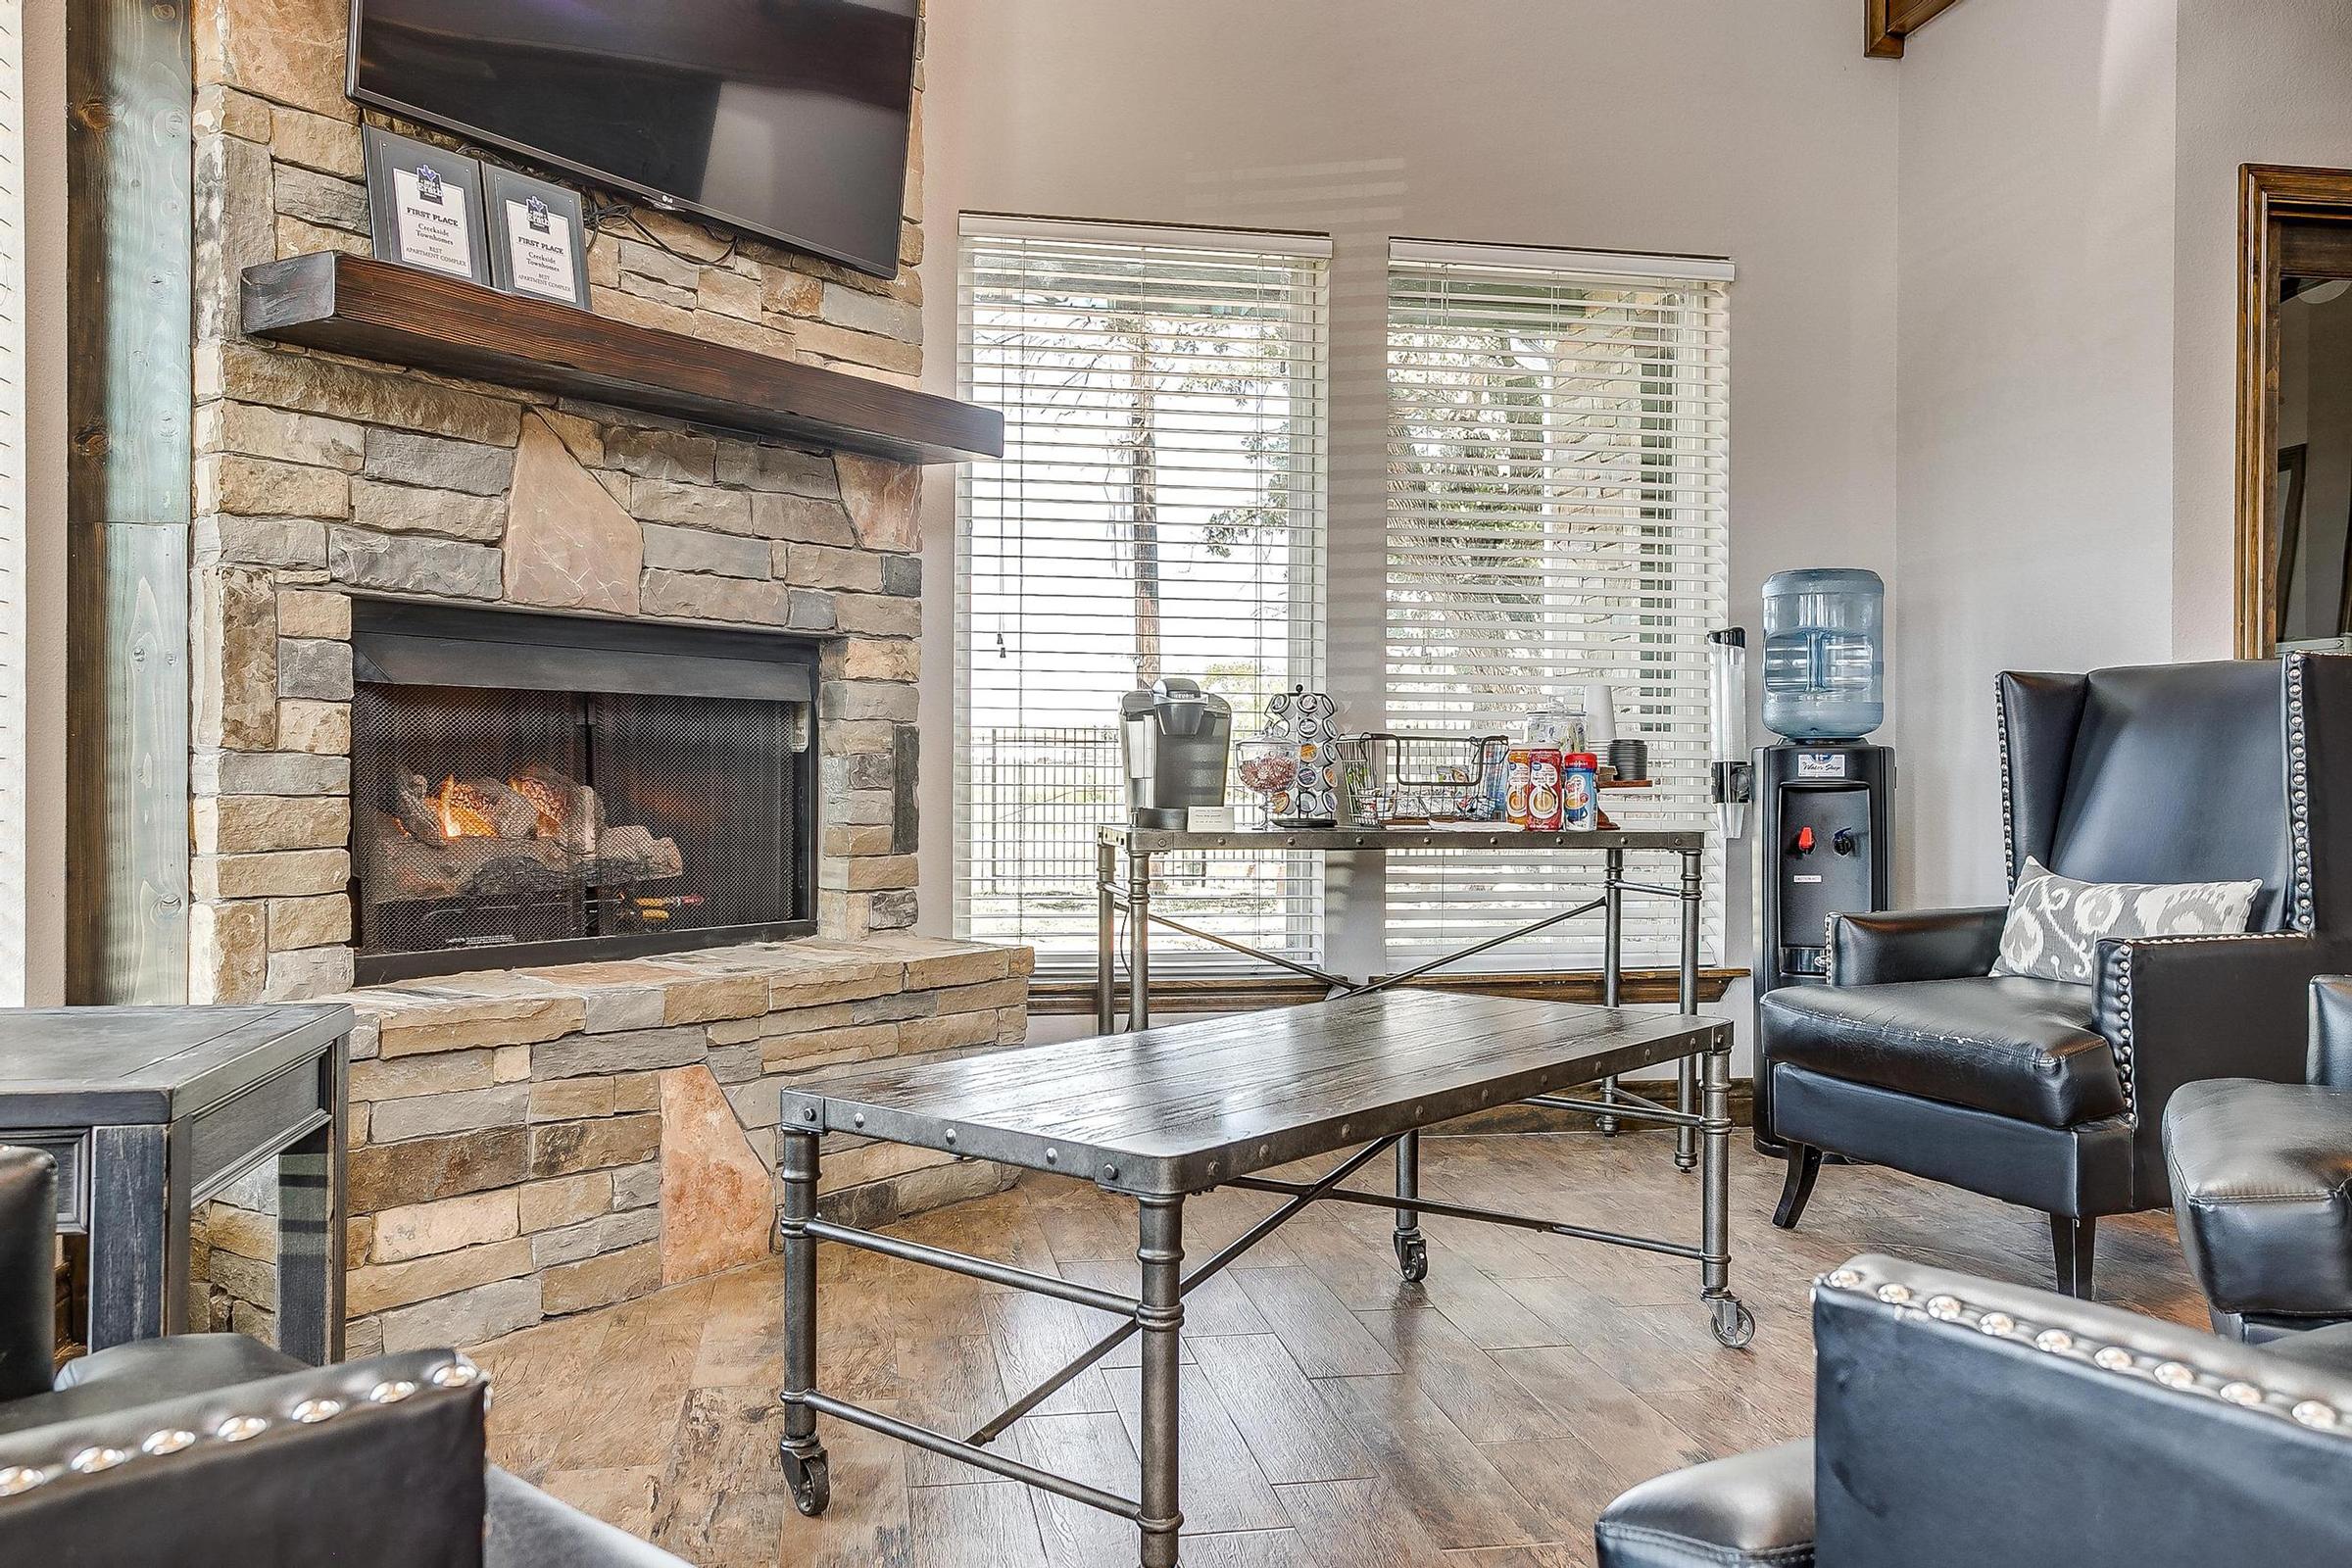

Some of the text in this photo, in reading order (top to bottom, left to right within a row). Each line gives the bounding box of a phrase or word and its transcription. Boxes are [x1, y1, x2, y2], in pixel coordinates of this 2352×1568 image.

[407, 207, 459, 226] FIRST PLACE
[416, 229, 454, 246] Townhomes
[417, 222, 449, 237] Creekside
[517, 236, 564, 255] FIRST PLACE
[406, 247, 466, 267] APARTMENT COMPLEX
[526, 258, 560, 272] Townhomes
[528, 251, 556, 265] Creekside
[517, 274, 571, 292] APARTMENT COMPLEX
